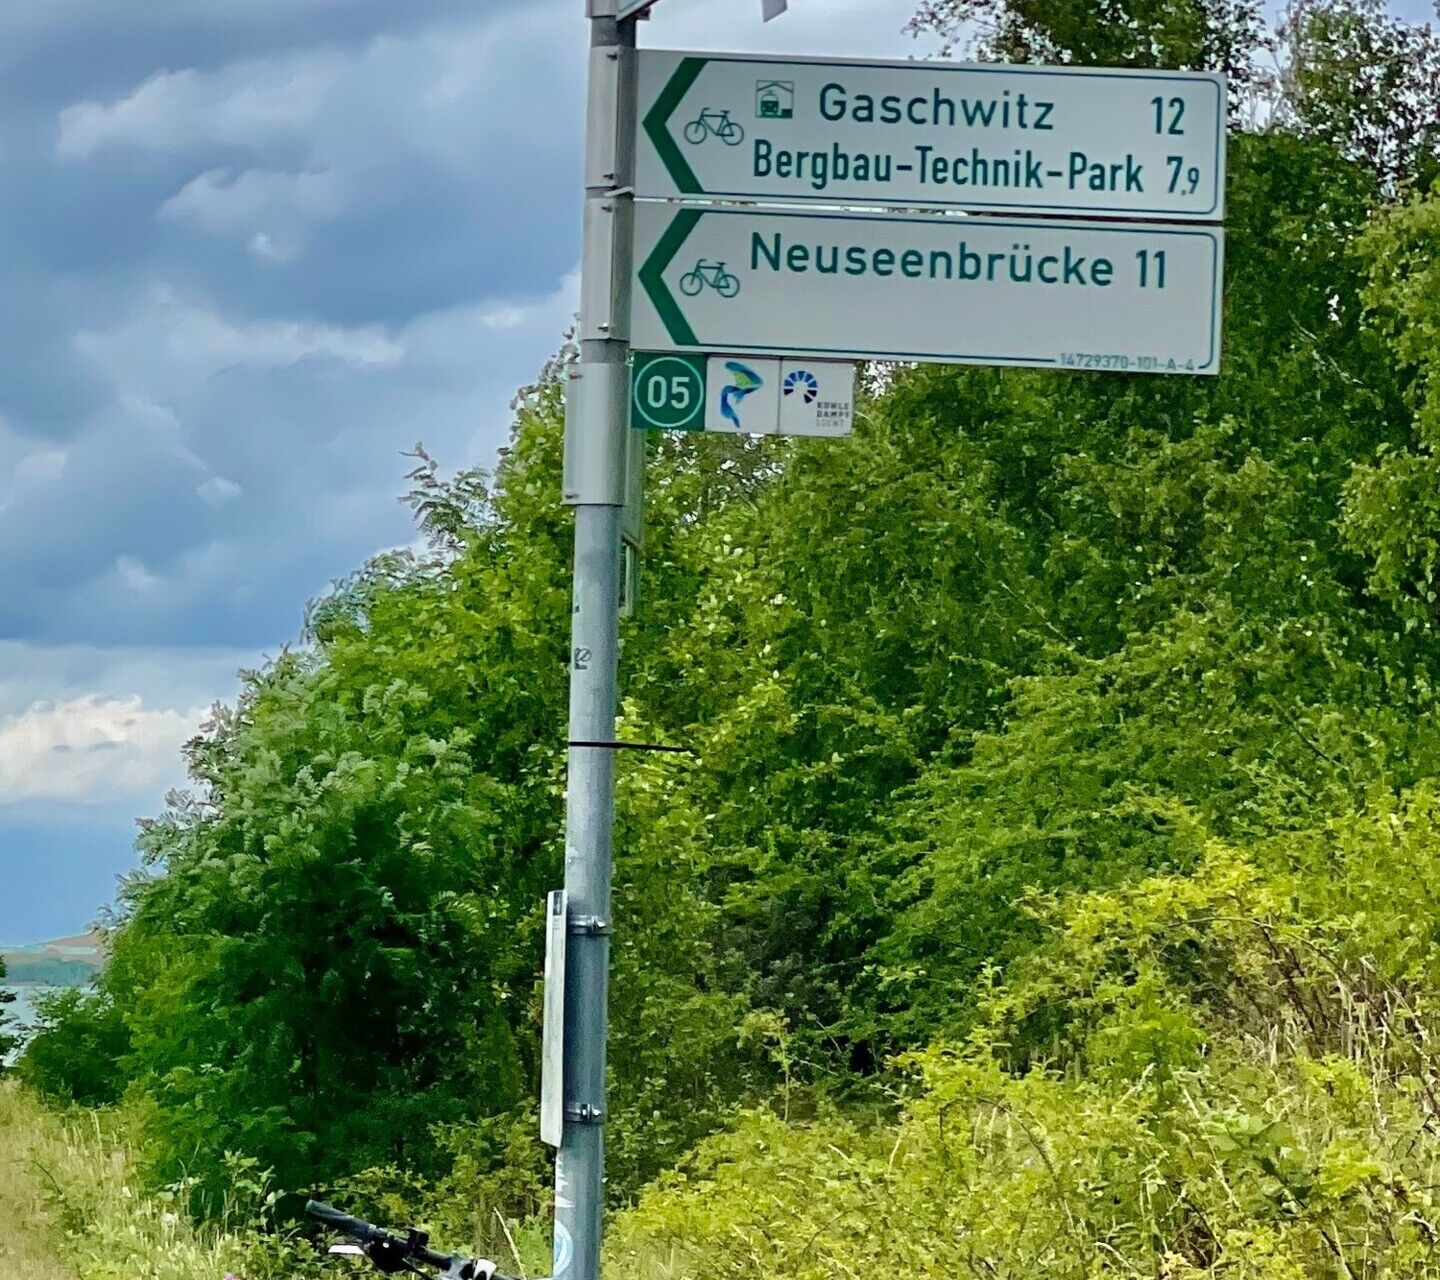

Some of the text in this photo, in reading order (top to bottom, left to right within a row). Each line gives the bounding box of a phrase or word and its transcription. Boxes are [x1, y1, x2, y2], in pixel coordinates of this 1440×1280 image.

[819, 83, 1185, 136] Gaschwitz 12
[753, 139, 1145, 193] Bergbau-Technik-Park
[750, 232, 1168, 289] Neuseenbrücke 11
[647, 375, 690, 410] 05
